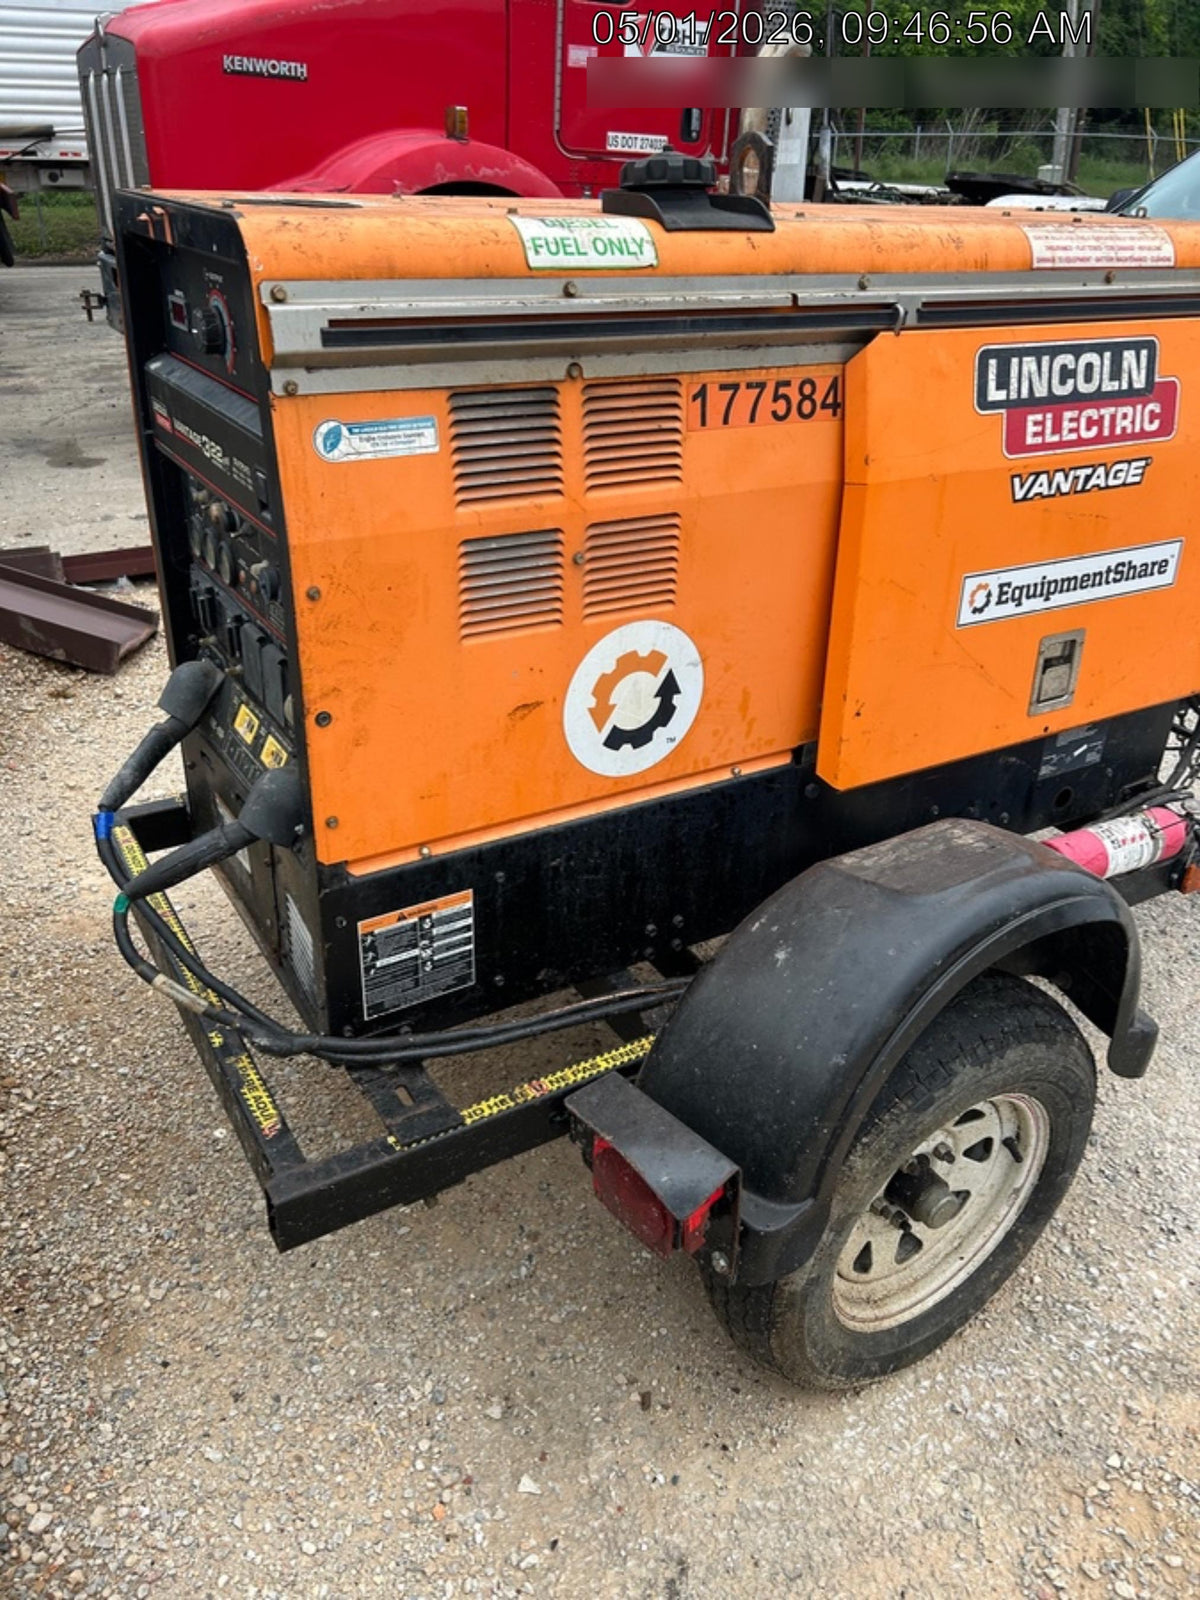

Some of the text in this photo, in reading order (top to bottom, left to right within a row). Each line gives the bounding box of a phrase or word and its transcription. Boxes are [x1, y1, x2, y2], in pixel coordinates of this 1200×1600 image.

[223, 55, 307, 78] KENWORTH
[608, 134, 619, 148] US
[621, 136, 638, 149] DOT
[530, 236, 645, 257] FUEL ONLY
[985, 348, 1149, 402] LINCOLN
[691, 375, 842, 428] 177584
[1025, 402, 1162, 446] ELECTRIC
[1012, 459, 1148, 501] VANTAGE
[995, 557, 1169, 608] EquipmentShare
